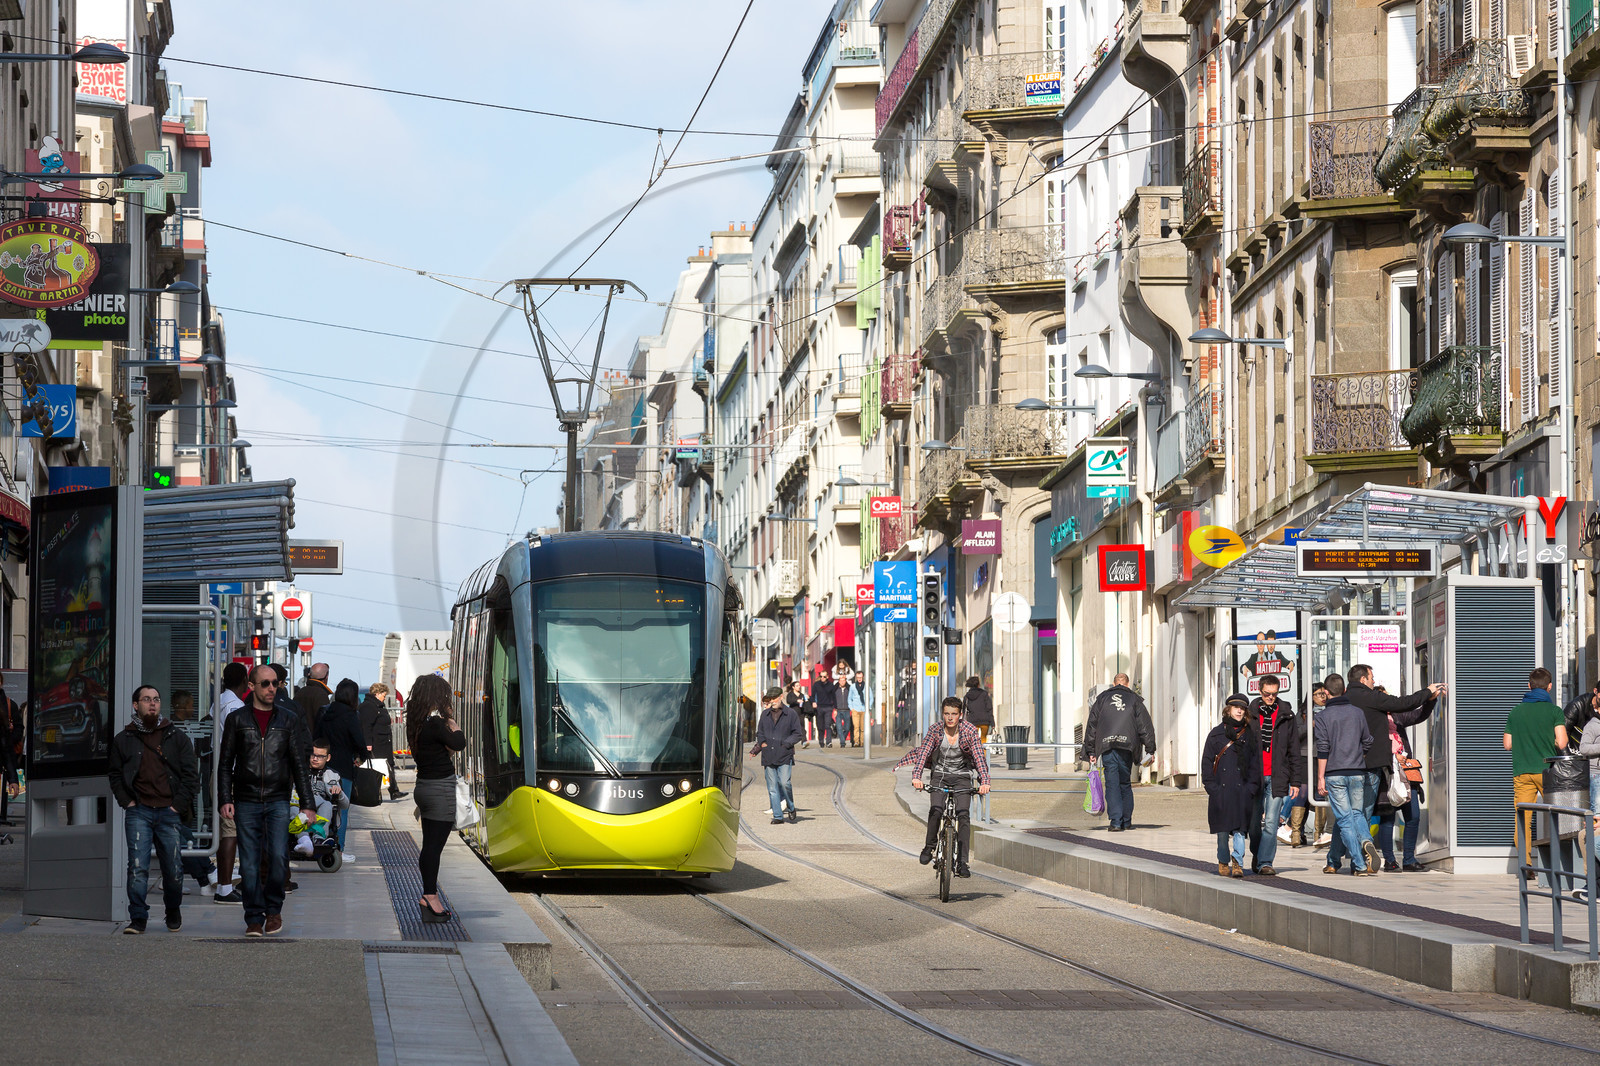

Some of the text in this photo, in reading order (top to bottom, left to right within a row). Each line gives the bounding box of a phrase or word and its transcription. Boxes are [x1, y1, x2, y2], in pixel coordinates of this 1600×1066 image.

[1035, 73, 1060, 81] LOUER
[1026, 81, 1060, 91] FONCIA
[48, 203, 77, 217] HAT
[6, 223, 81, 241] TAVERNE
[3, 283, 79, 300] SAINT MARTIN
[83, 313, 126, 327] photo
[0, 331, 21, 343] MU
[872, 500, 900, 511] ORPI
[974, 531, 996, 539] ALAIN
[963, 539, 996, 547] AFFLELOU
[858, 587, 875, 599] OR
[53, 617, 72, 637] Cap
[927, 665, 937, 673] 40
[1256, 661, 1281, 674] MATMUT
